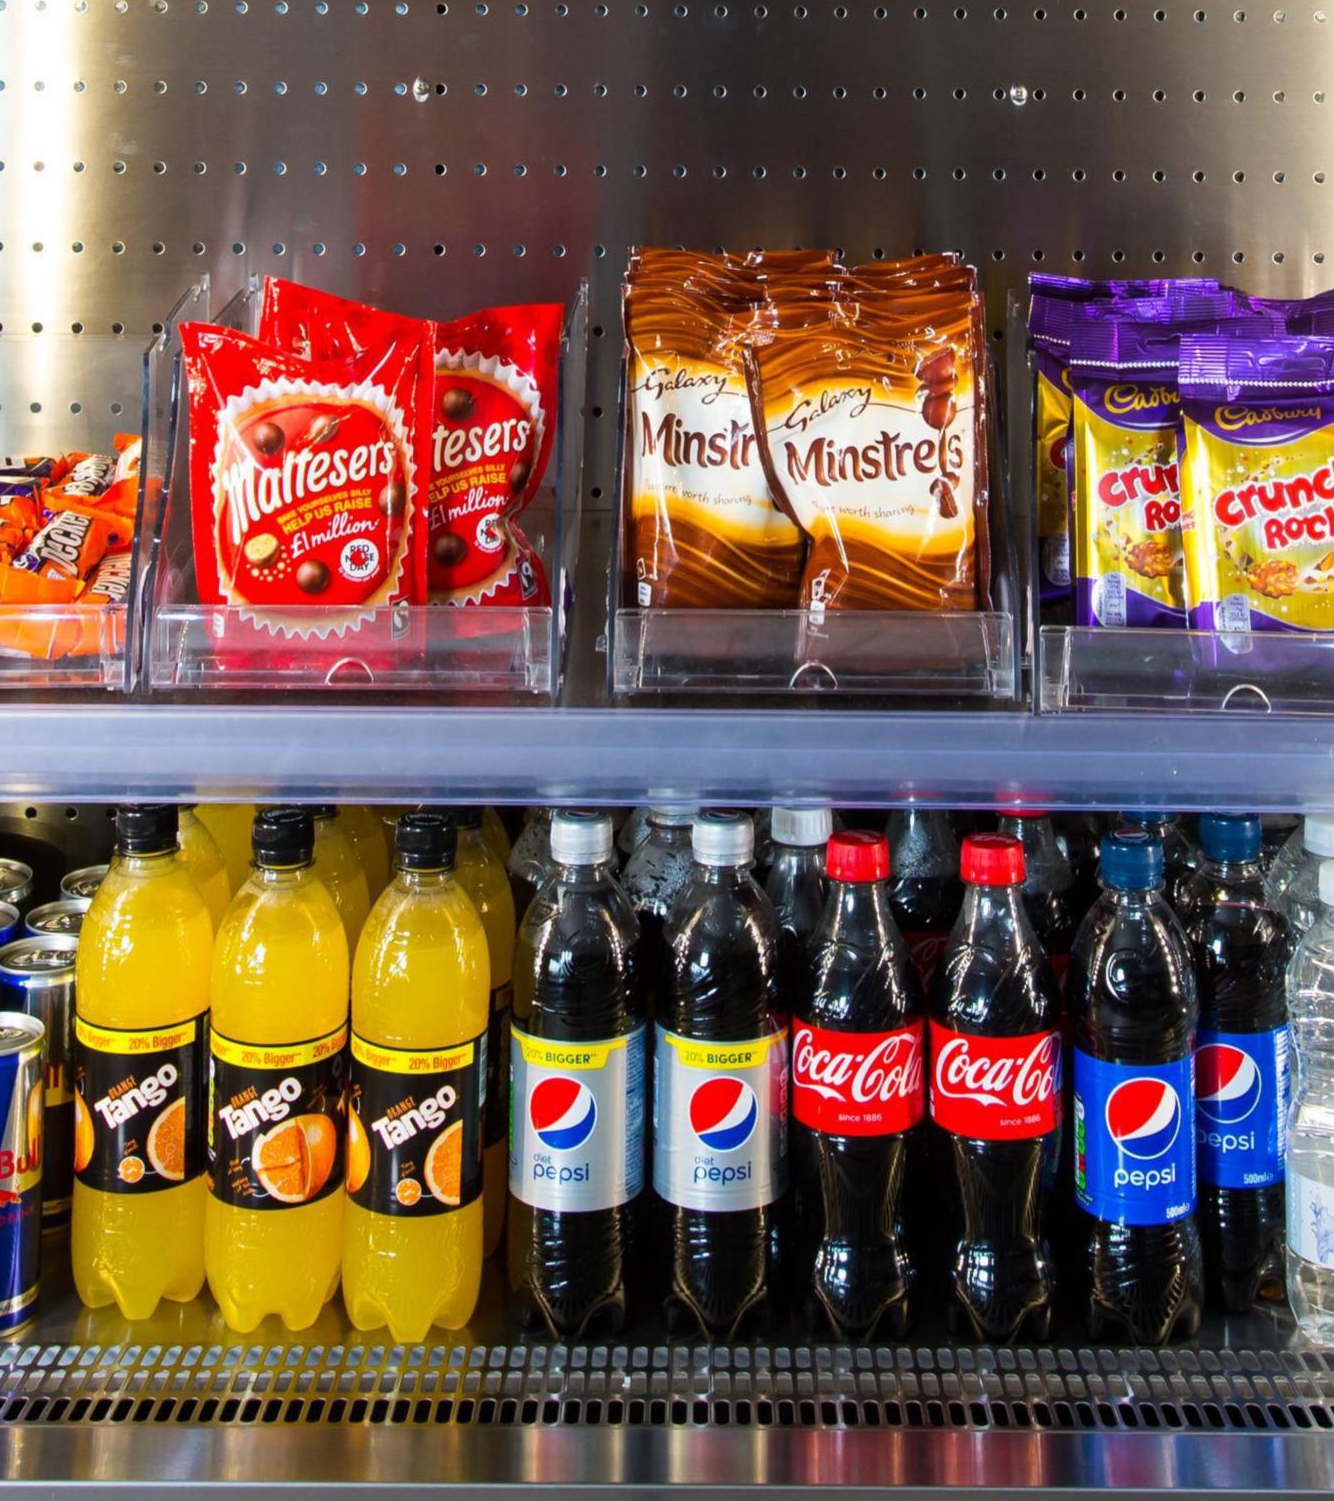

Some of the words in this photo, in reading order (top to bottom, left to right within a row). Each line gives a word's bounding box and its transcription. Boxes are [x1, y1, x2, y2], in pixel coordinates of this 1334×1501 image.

[634, 366, 729, 405] Galaxy
[774, 383, 875, 432] Galaxy
[1103, 384, 1180, 415] Cadbu
[1214, 404, 1322, 431] Cadbury
[431, 418, 529, 473] tesers
[640, 411, 757, 471] Minstr
[784, 430, 966, 488] Minstrels
[222, 440, 395, 546] Maltesers
[428, 487, 451, 504] ELP
[451, 479, 469, 494] US
[469, 472, 507, 487] RAISE
[282, 512, 313, 535] HELP
[314, 504, 333, 520] US
[334, 496, 373, 514] RAISE
[838, 503, 871, 518] worth
[873, 503, 916, 519] sharing
[344, 552, 375, 563] NSE
[349, 562, 370, 572] DAY
[128, 1037, 150, 1050] 20%
[684, 1050, 704, 1063] 20%
[408, 1057, 430, 1071] 20%
[793, 1028, 924, 1104] Coca-Cola
[935, 1030, 1063, 1108] Coca-Col
[94, 1062, 179, 1130] Tango
[218, 1076, 303, 1141] Tango
[370, 1084, 457, 1151] Tango
[837, 1112, 861, 1123] since
[863, 1112, 883, 1123] 1886
[998, 1116, 1022, 1127] since
[1023, 1113, 1042, 1125] 1886
[1196, 1130, 1255, 1153] pepsi
[533, 1152, 553, 1165] diet
[694, 1155, 715, 1167] diet
[532, 1163, 590, 1186] pepsi
[693, 1161, 752, 1187] pepsi
[1113, 1163, 1177, 1190] pepsi
